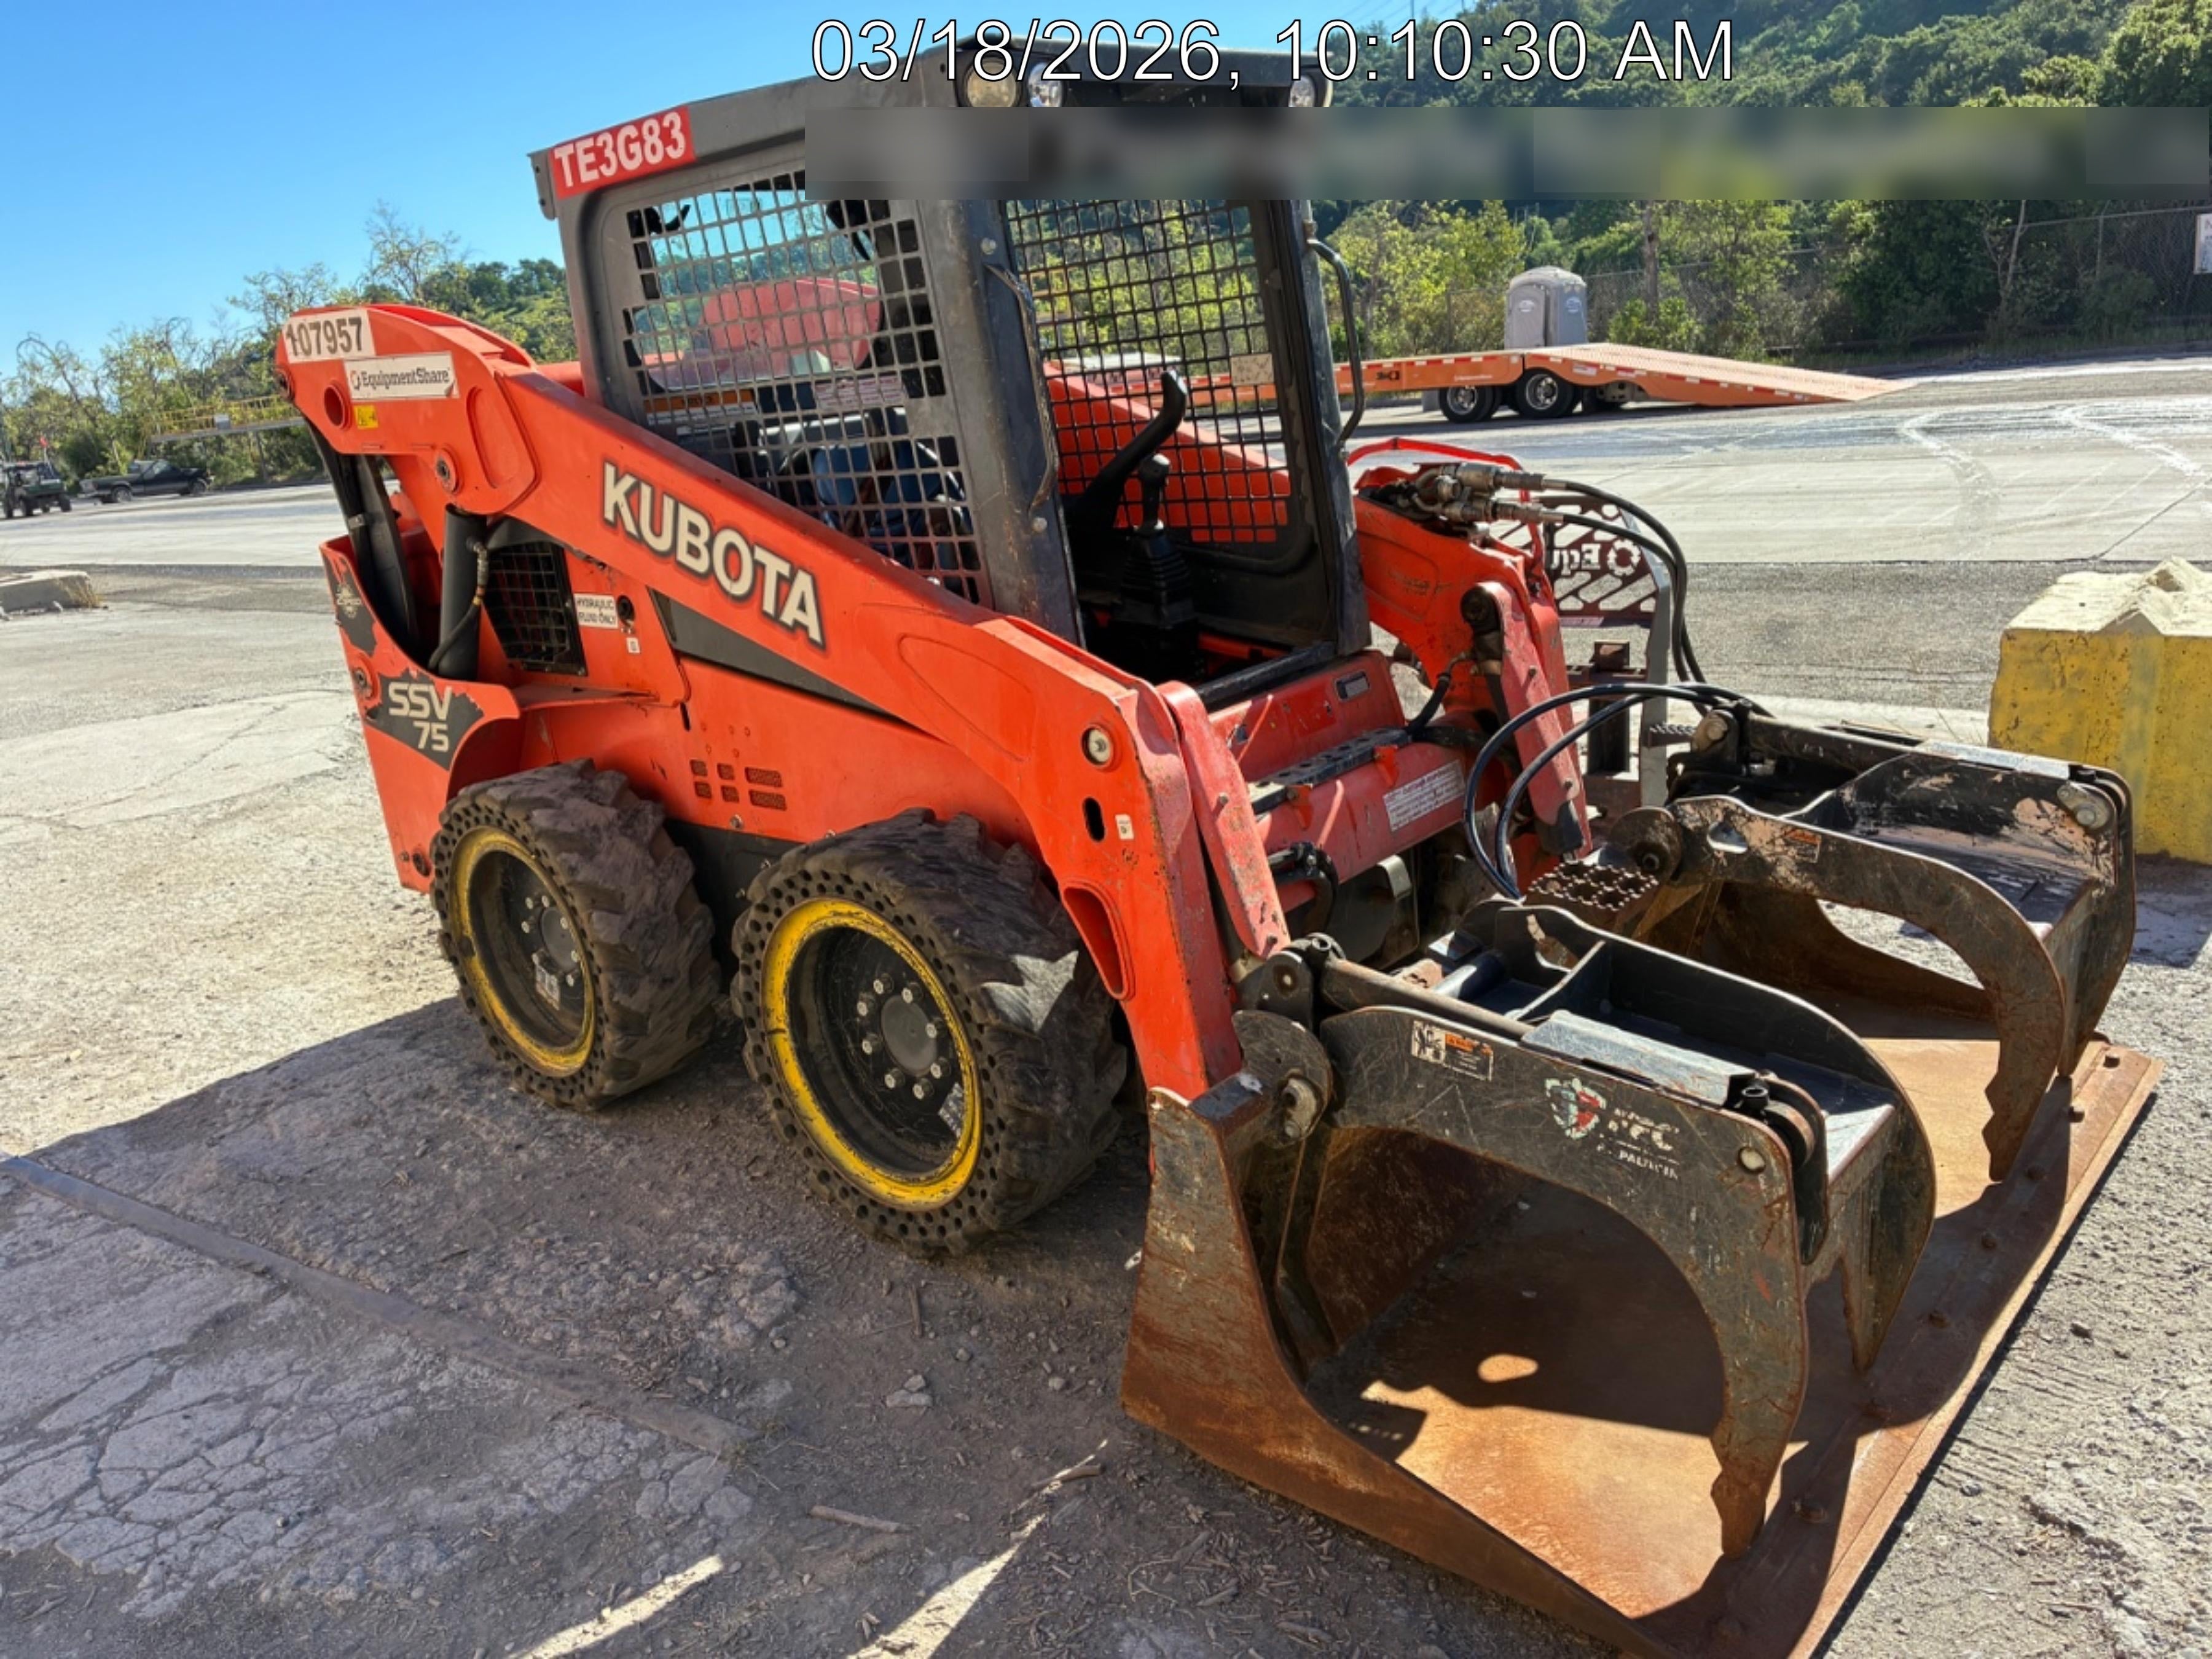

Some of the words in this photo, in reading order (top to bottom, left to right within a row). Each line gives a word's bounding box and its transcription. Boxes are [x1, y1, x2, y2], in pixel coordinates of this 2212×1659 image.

[554, 111, 686, 187] TE3G83
[286, 316, 363, 357] 107957
[360, 366, 450, 390] EquipmentShare
[602, 460, 824, 648] KUBOTA
[388, 681, 453, 722] SSV
[412, 720, 450, 753] 75
